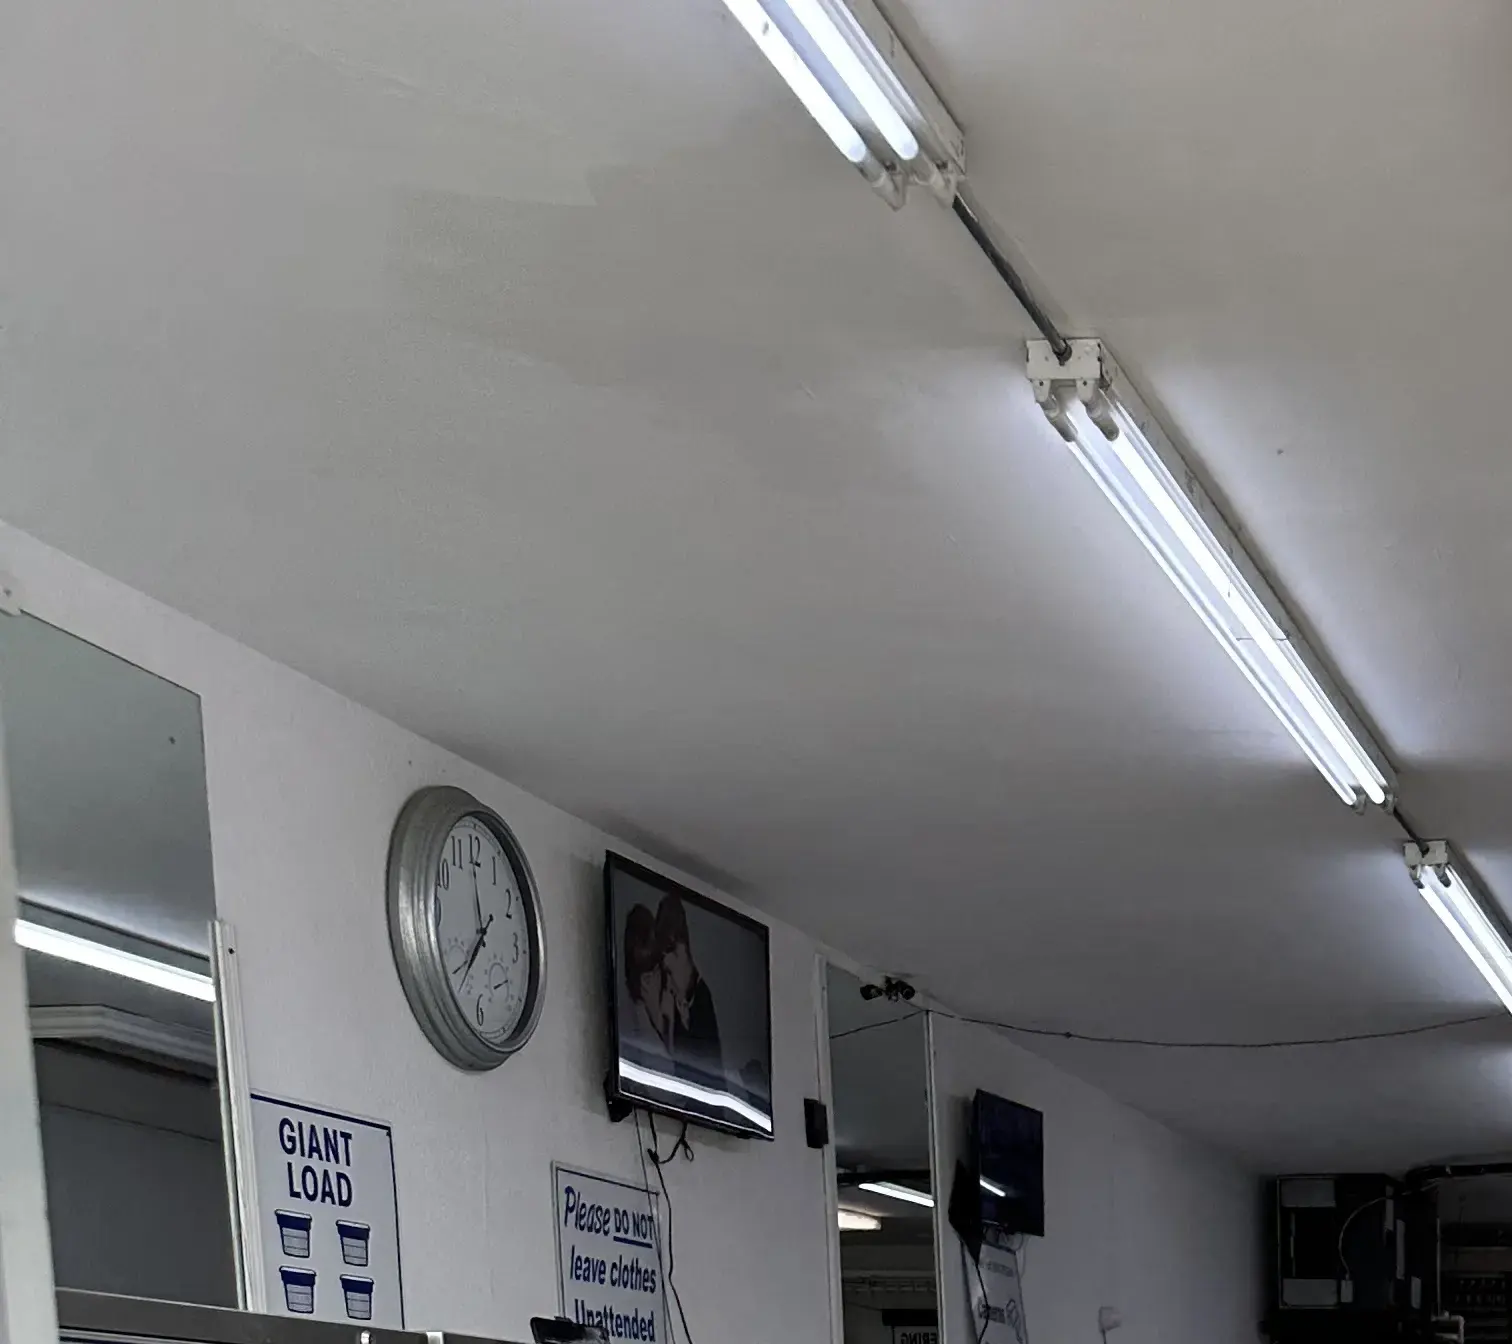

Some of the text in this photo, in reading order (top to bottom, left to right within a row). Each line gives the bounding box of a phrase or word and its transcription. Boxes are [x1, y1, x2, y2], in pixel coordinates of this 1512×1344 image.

[452, 835, 464, 870] 11
[468, 834, 481, 868] 12
[492, 856, 498, 886] 1
[505, 889, 512, 920] 2
[513, 932, 519, 964] 3
[476, 993, 484, 1026] 6
[279, 1117, 353, 1166] GIANT
[287, 1162, 353, 1207] LOAD
[564, 1186, 654, 1241] Please DO NOT
[569, 1245, 657, 1293] leave clothes
[574, 1298, 656, 1342] Unattended
